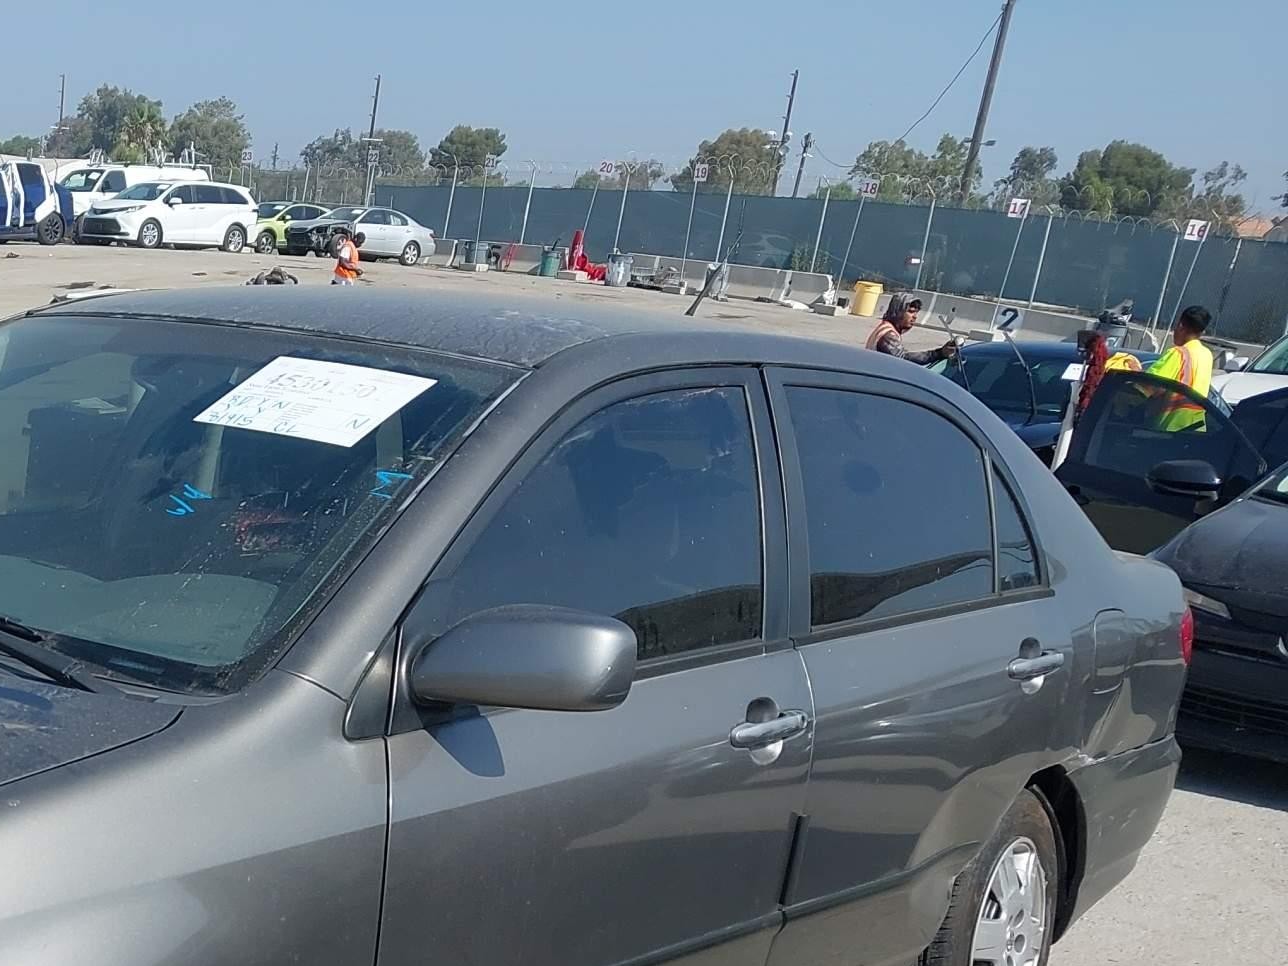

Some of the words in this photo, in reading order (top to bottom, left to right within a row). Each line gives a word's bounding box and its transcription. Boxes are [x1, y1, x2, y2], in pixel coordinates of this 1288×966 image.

[600, 161, 613, 173] 20
[695, 167, 707, 179] 19
[862, 182, 877, 195] 18
[1009, 202, 1027, 215] 17
[1187, 225, 1208, 238] 16
[997, 307, 1020, 332] 2
